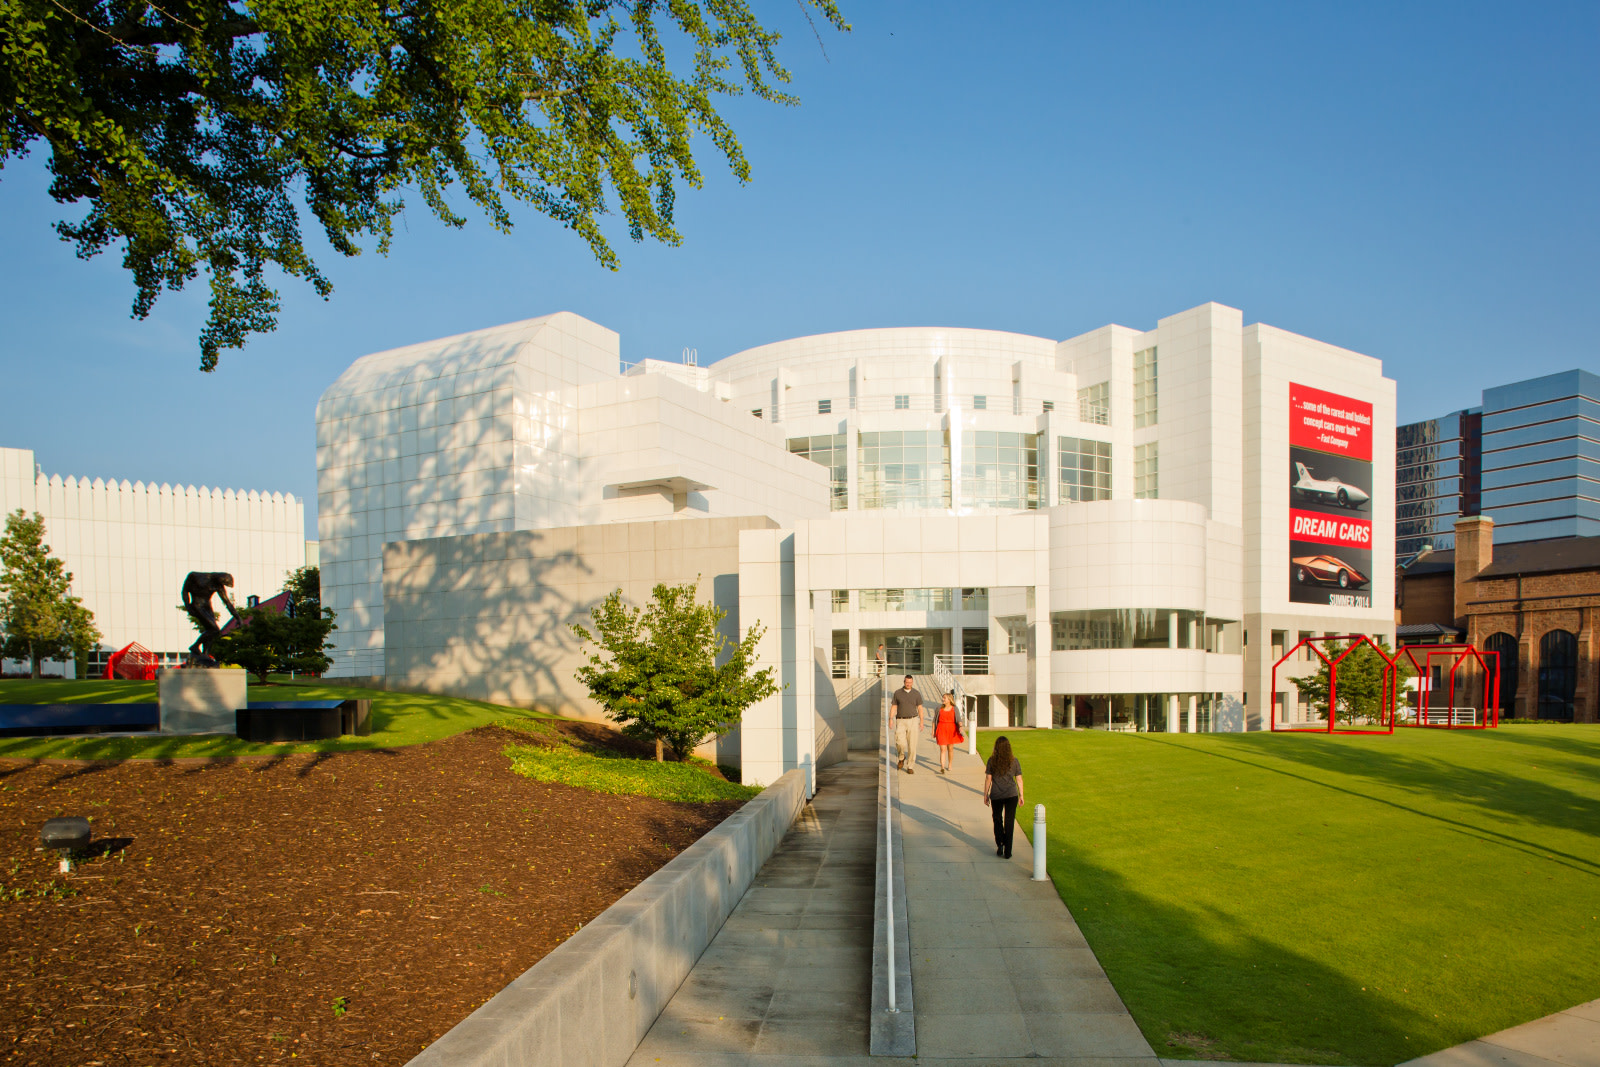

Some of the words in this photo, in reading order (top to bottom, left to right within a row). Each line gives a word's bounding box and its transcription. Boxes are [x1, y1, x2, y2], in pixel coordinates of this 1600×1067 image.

[1317, 403, 1322, 413] of
[1331, 408, 1345, 419] rarest
[1345, 411, 1354, 421] and
[1303, 416, 1323, 430] concept
[1324, 421, 1334, 431] cars
[1335, 423, 1346, 433] ever
[1294, 516, 1337, 538] DREAM
[1339, 523, 1370, 543] CARS
[1329, 593, 1355, 607] SUMMER
[1355, 596, 1369, 608] 2014
